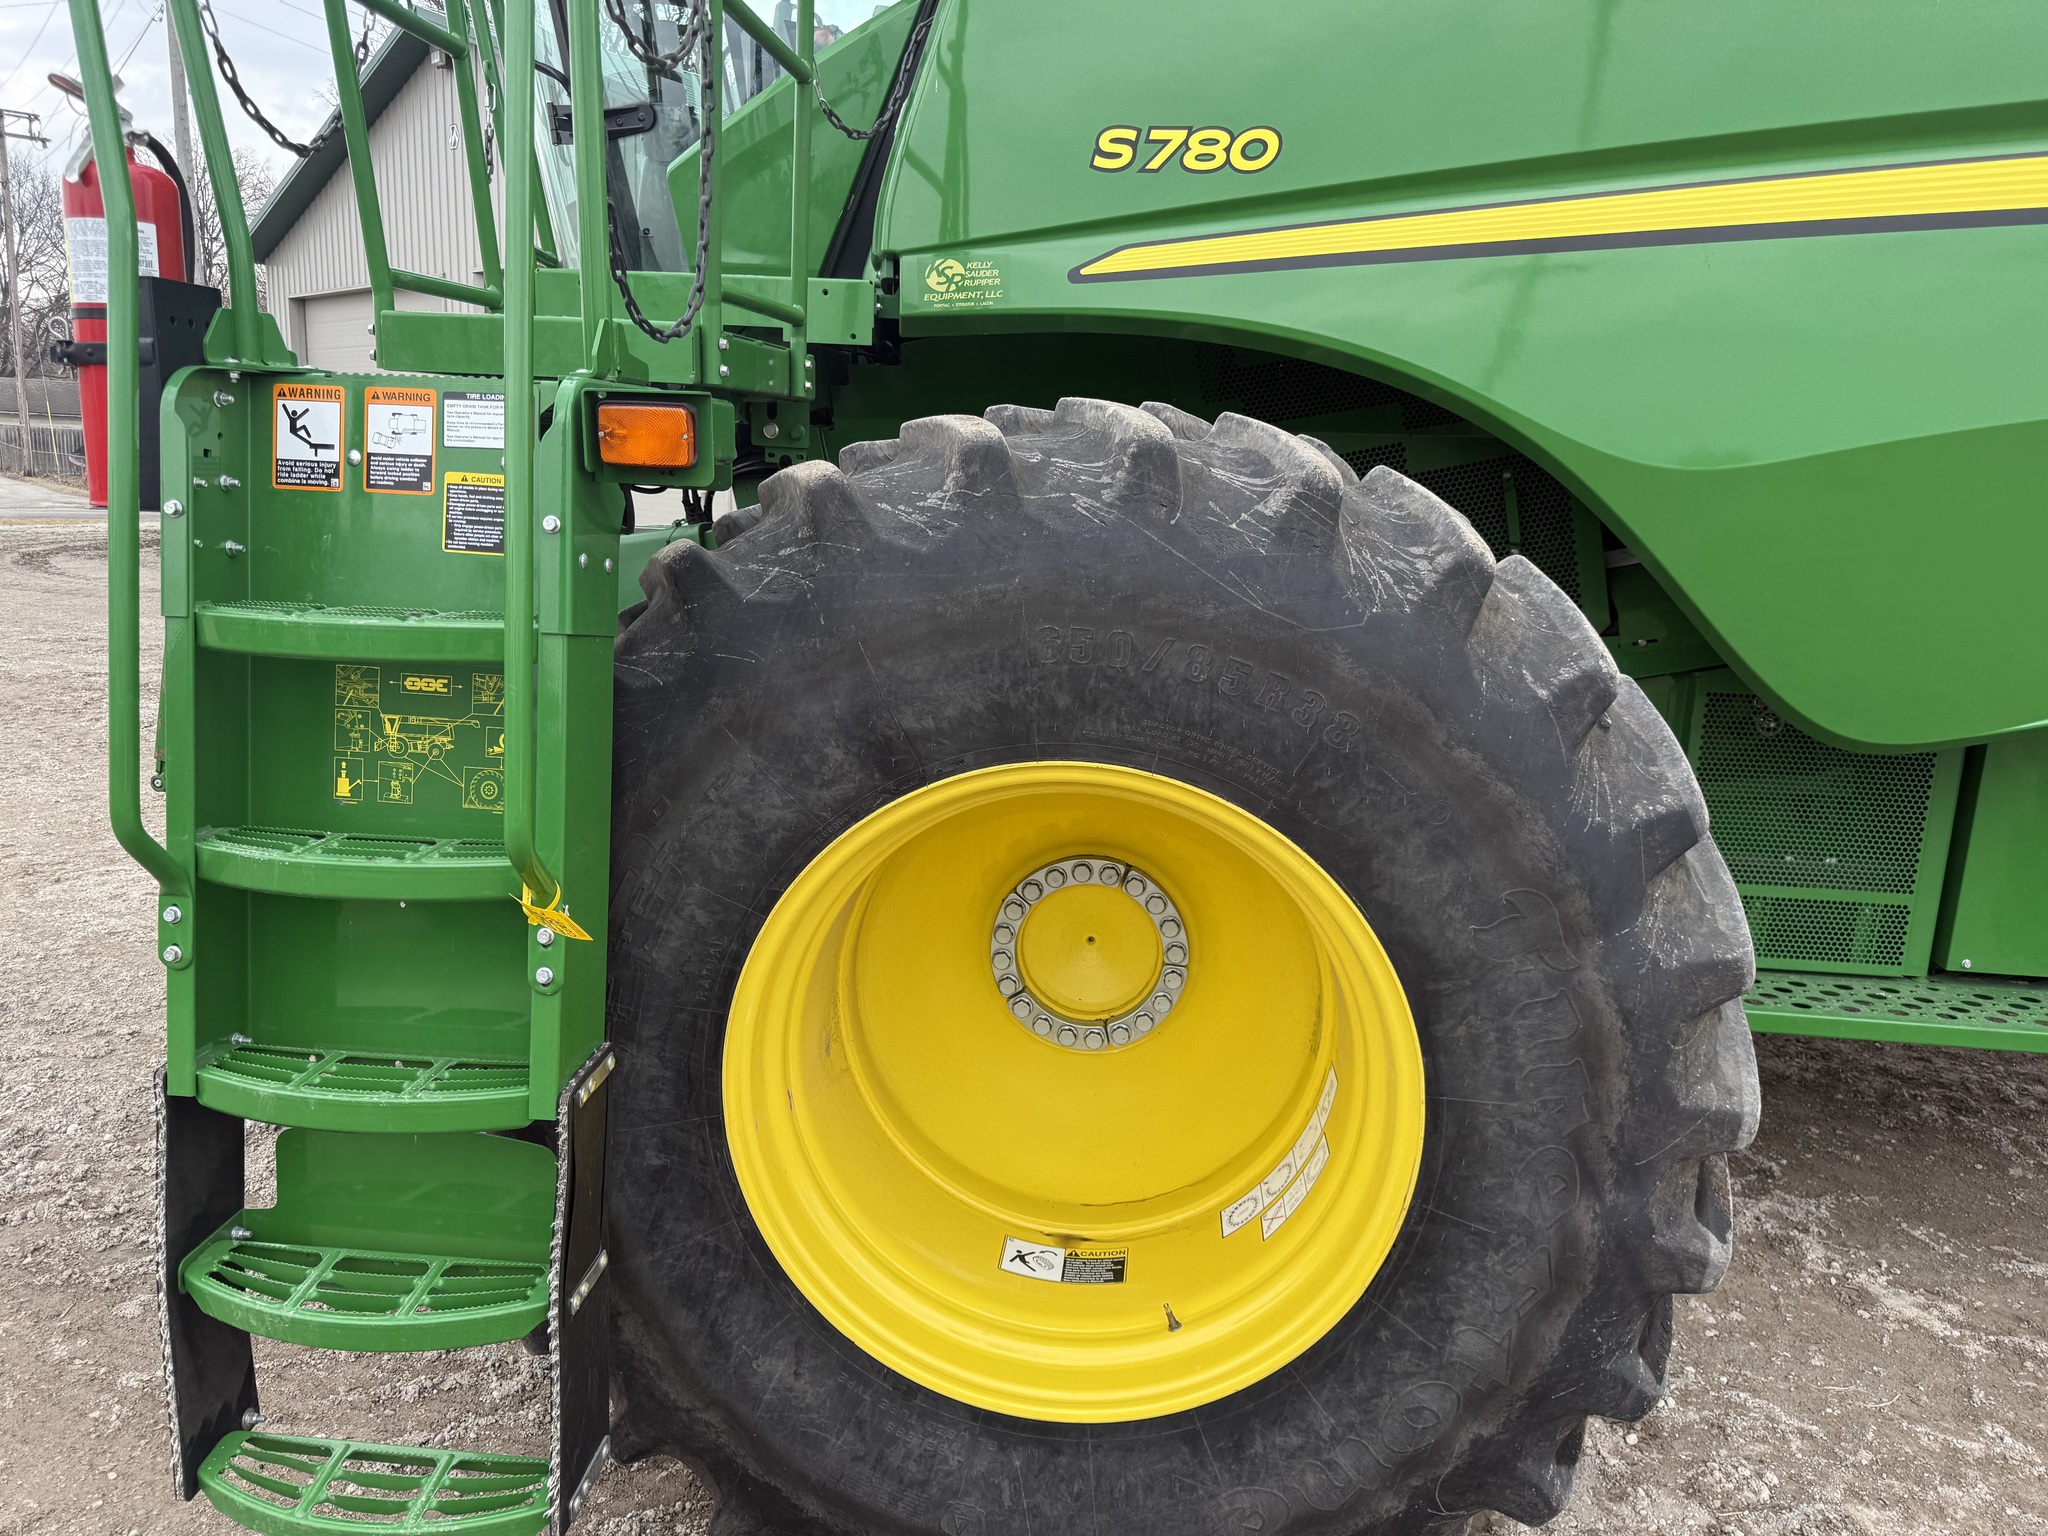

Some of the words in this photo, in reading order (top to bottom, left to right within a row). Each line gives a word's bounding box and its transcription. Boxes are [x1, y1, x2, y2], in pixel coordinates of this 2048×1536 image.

[1089, 125, 1283, 174] S780
[966, 261, 993, 269] KELLY
[965, 269, 999, 278] SAUDER
[964, 278, 1000, 286] RUPIPER
[924, 291, 984, 301] EQUIPMENT,
[985, 290, 1003, 298] LLC
[288, 388, 341, 399] WARNING
[382, 392, 430, 401] WARNING
[319, 461, 336, 469] injury
[471, 476, 501, 484] CAUTION
[1037, 625, 1361, 750] 650/85R38
[1140, 718, 1183, 733] TRACTOR
[1183, 729, 1212, 744] DRIVE
[1245, 753, 1284, 777] SERVICE
[1210, 888, 1591, 1536] Firestone
